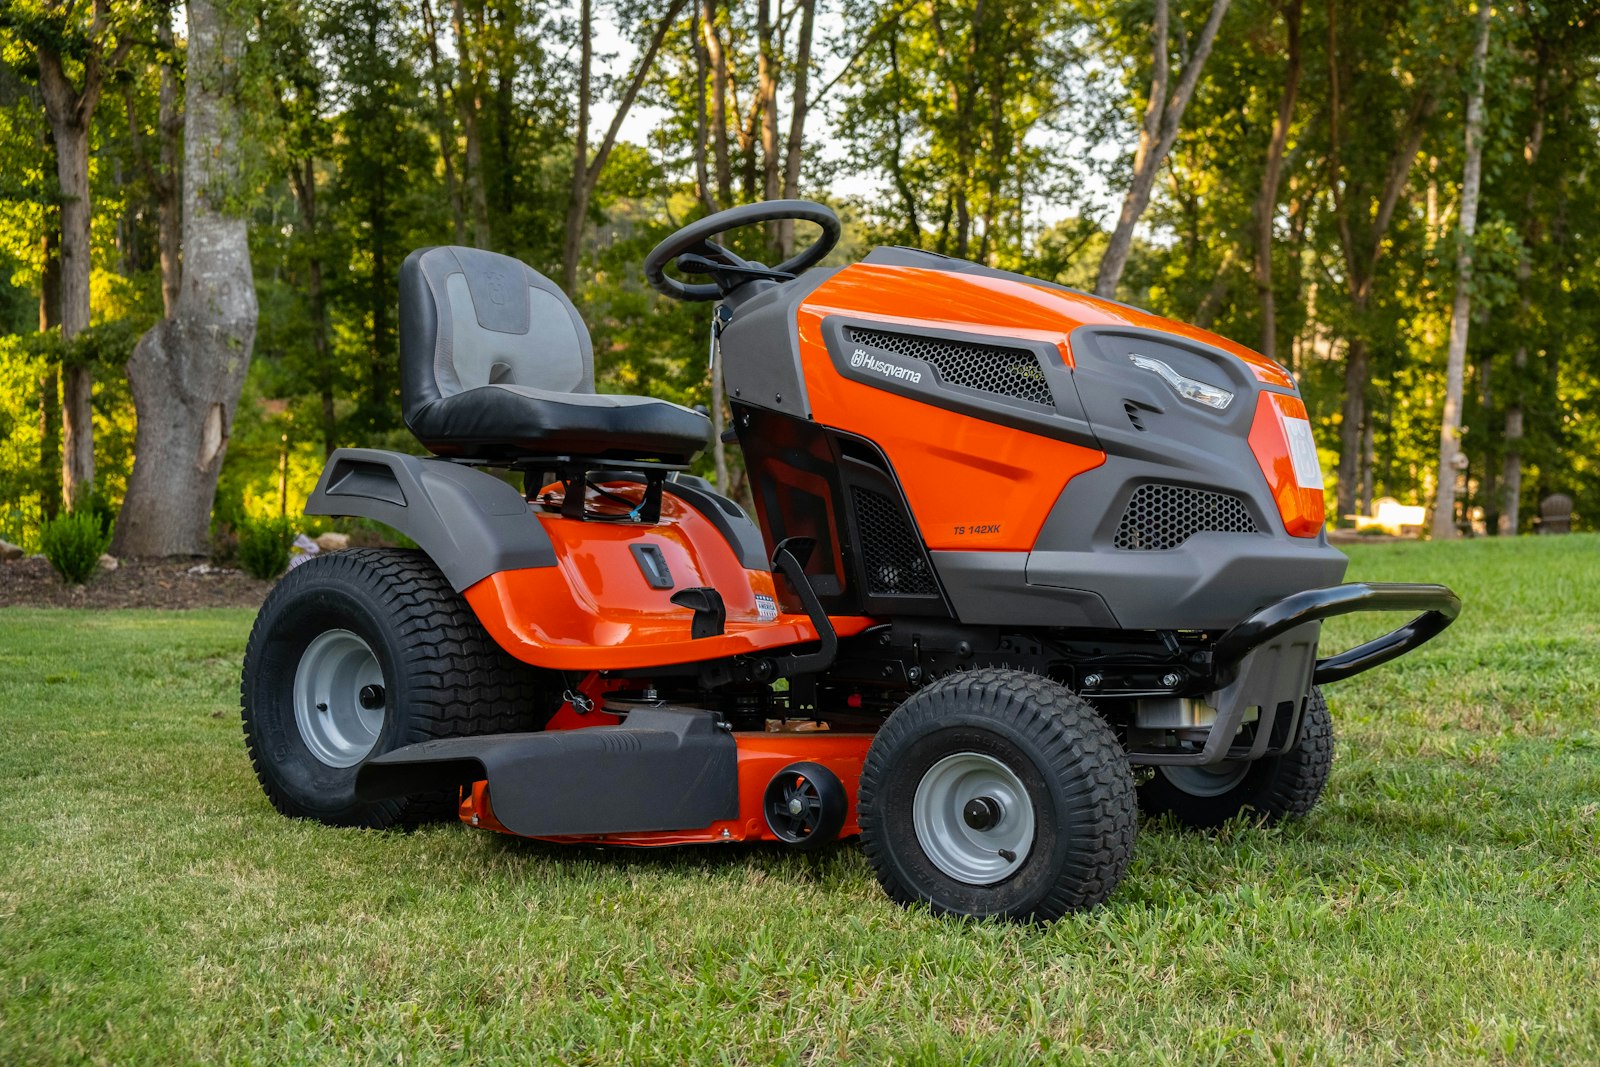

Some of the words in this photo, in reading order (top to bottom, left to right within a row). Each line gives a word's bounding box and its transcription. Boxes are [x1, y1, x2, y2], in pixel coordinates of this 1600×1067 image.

[862, 353, 921, 383] Husqvarna
[954, 526, 965, 535] TS
[969, 524, 1001, 534] 142XK
